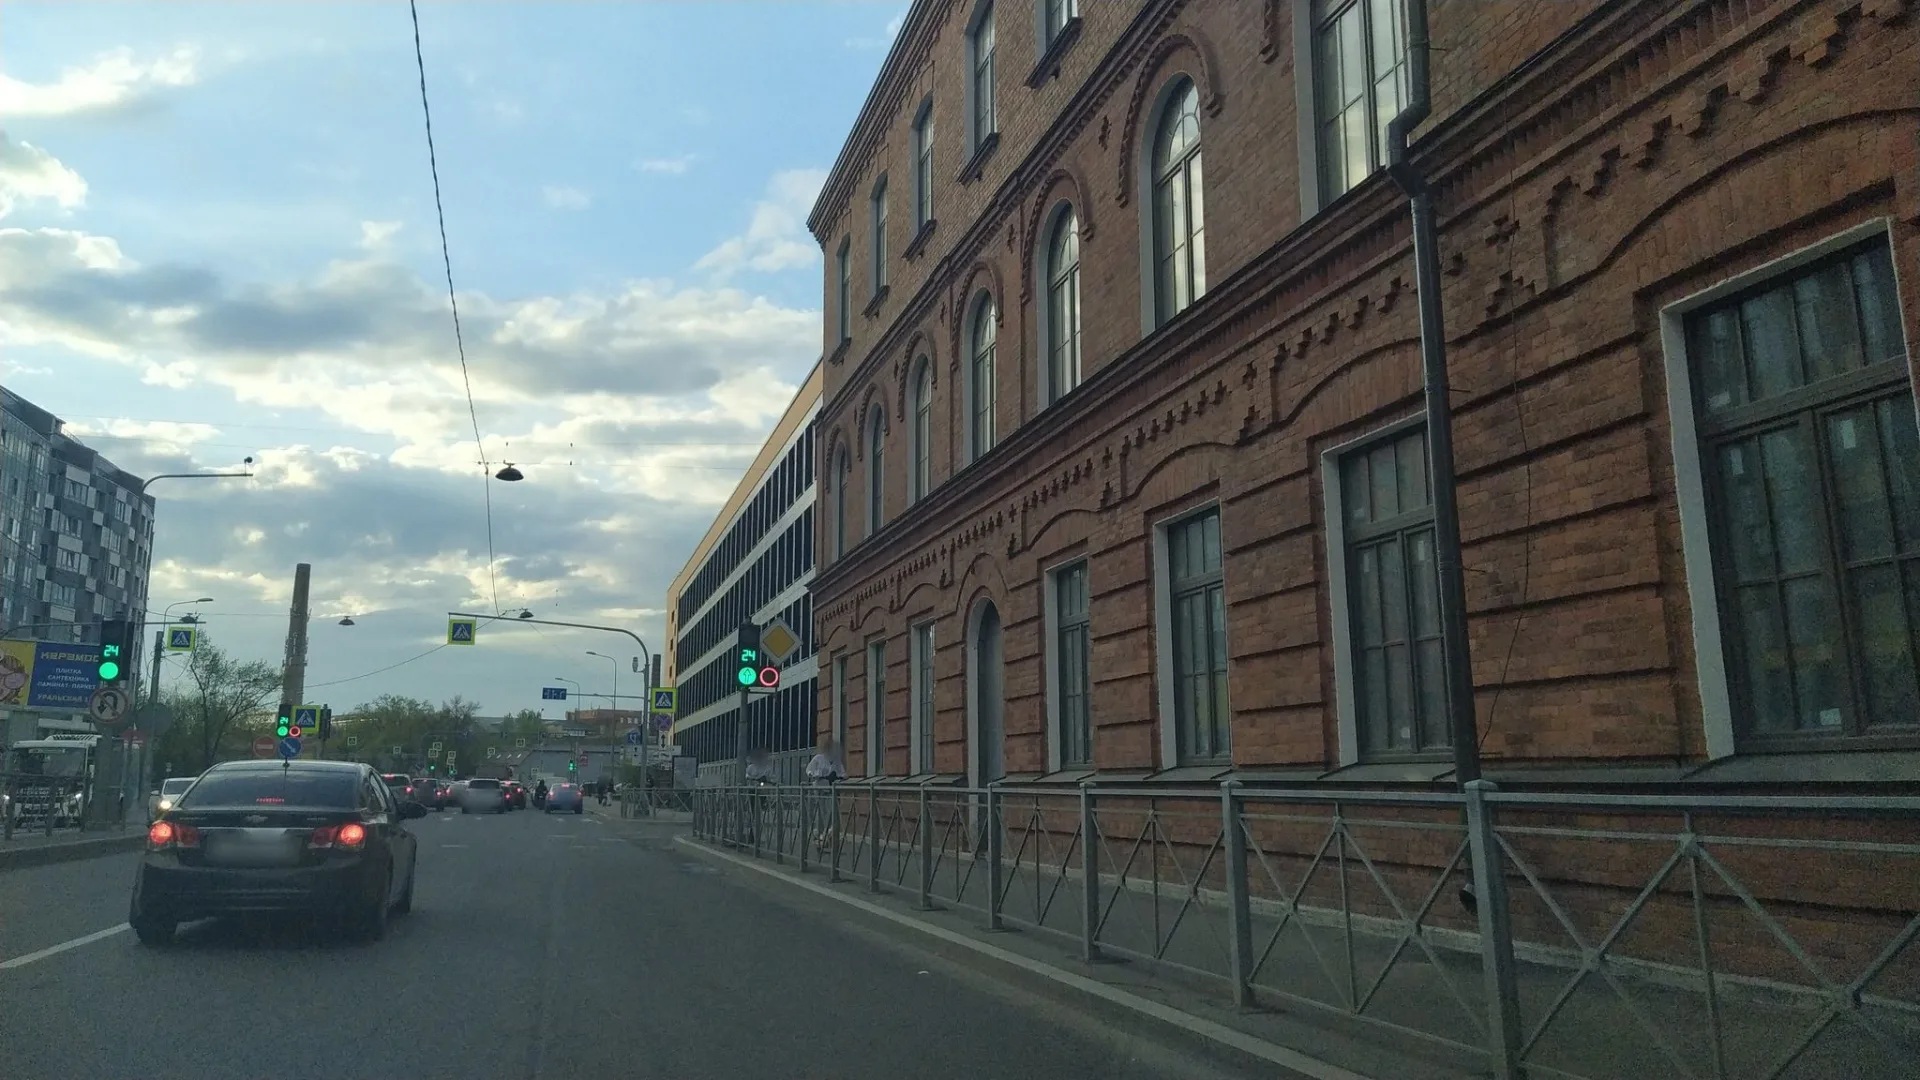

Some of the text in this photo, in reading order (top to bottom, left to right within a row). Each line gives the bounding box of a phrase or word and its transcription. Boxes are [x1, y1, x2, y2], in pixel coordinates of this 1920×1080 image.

[103, 644, 119, 657] 24
[741, 649, 756, 661] 24
[48, 674, 90, 682] САНТЕХНИКА
[279, 716, 289, 724] 24
